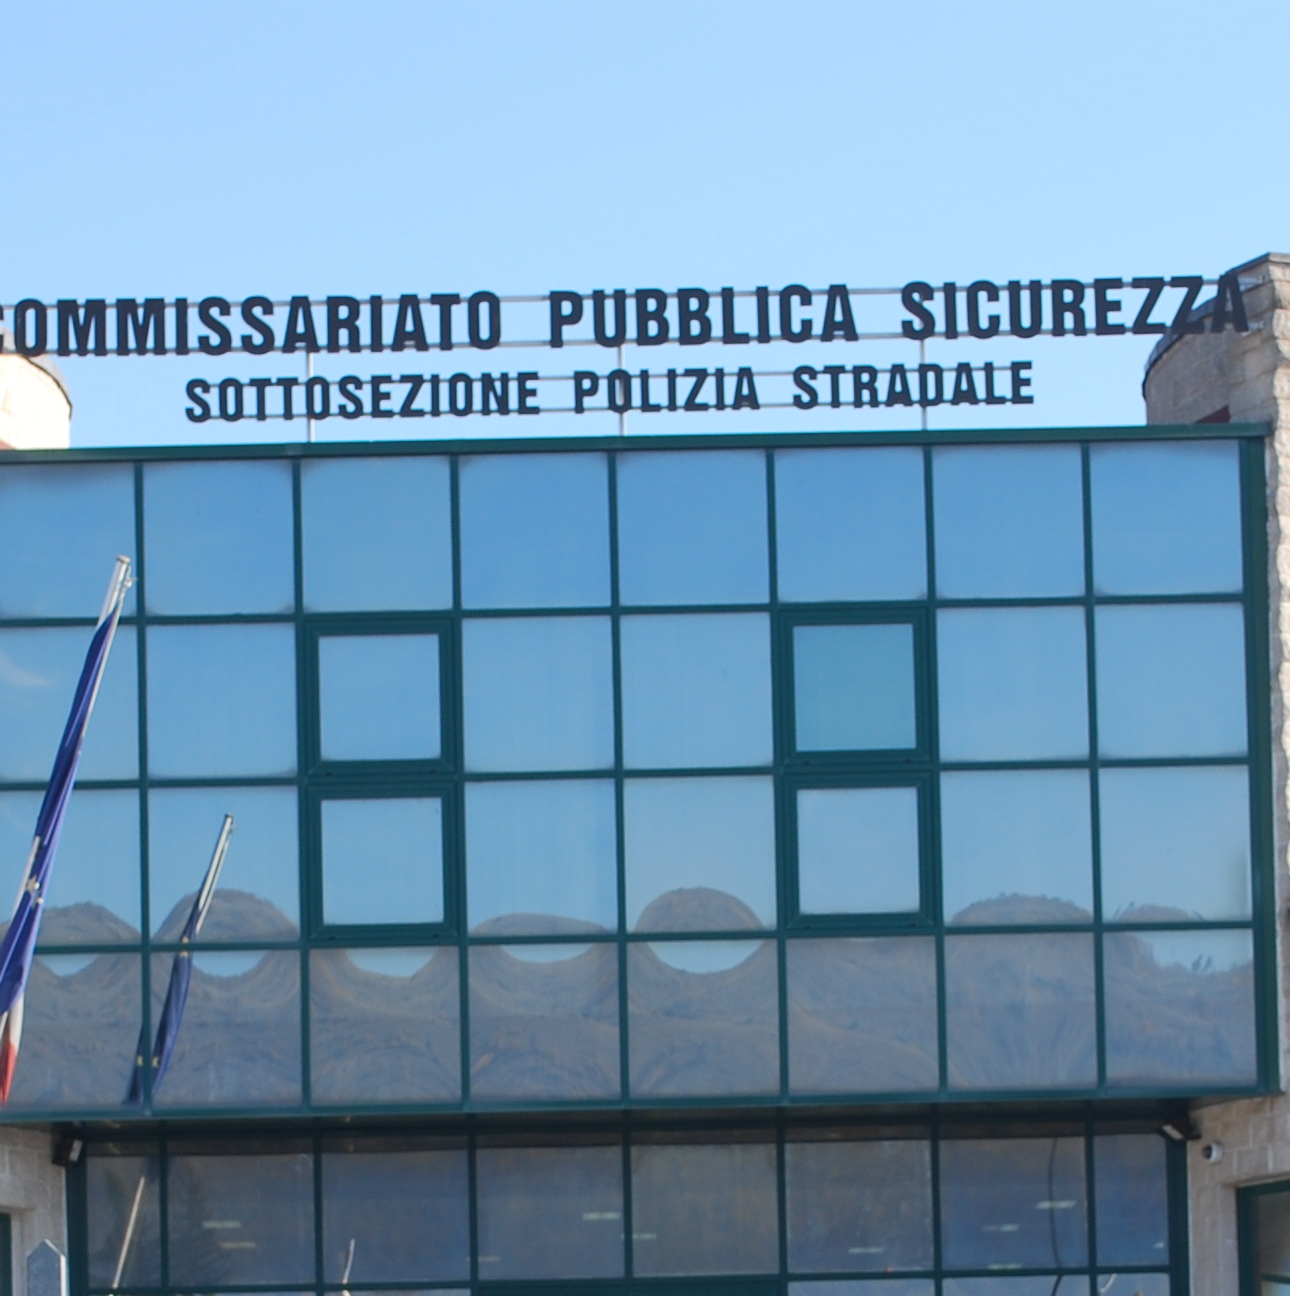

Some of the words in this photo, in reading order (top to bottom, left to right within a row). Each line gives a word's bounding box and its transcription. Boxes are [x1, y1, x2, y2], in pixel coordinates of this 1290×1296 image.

[549, 283, 859, 349] PUBBLICA
[900, 274, 1250, 340] SICUREZZA
[184, 371, 541, 424] SOTTOSEZIONE
[573, 366, 761, 414] POLIZIA
[791, 360, 1035, 409] STRADALE
